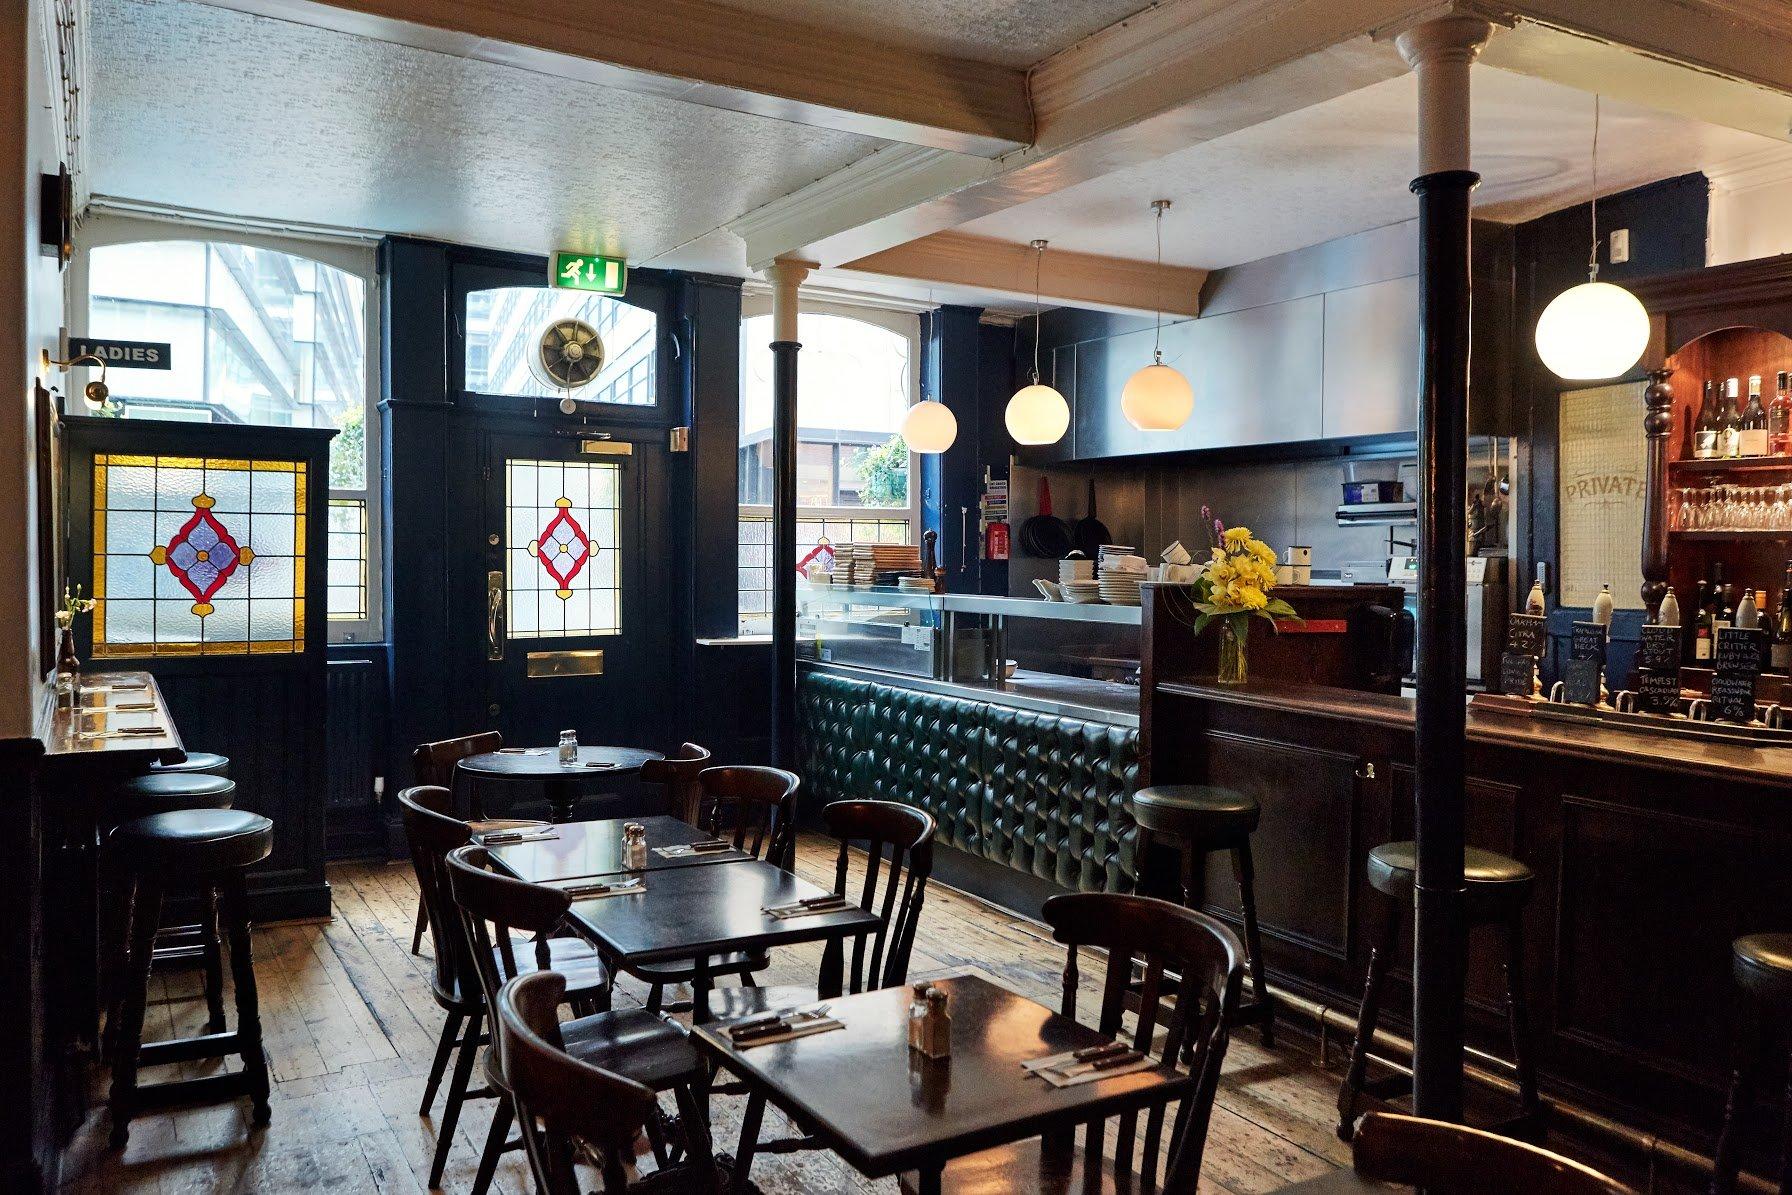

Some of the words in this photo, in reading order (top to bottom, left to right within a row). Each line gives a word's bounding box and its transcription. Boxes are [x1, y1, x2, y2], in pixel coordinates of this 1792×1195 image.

[80, 345, 160, 362] LADIES
[1718, 630, 1750, 640] LITTLE
[1717, 641, 1760, 653] CRITTER
[1639, 674, 1677, 686] TEMPEST
[1723, 705, 1744, 717] 6%
